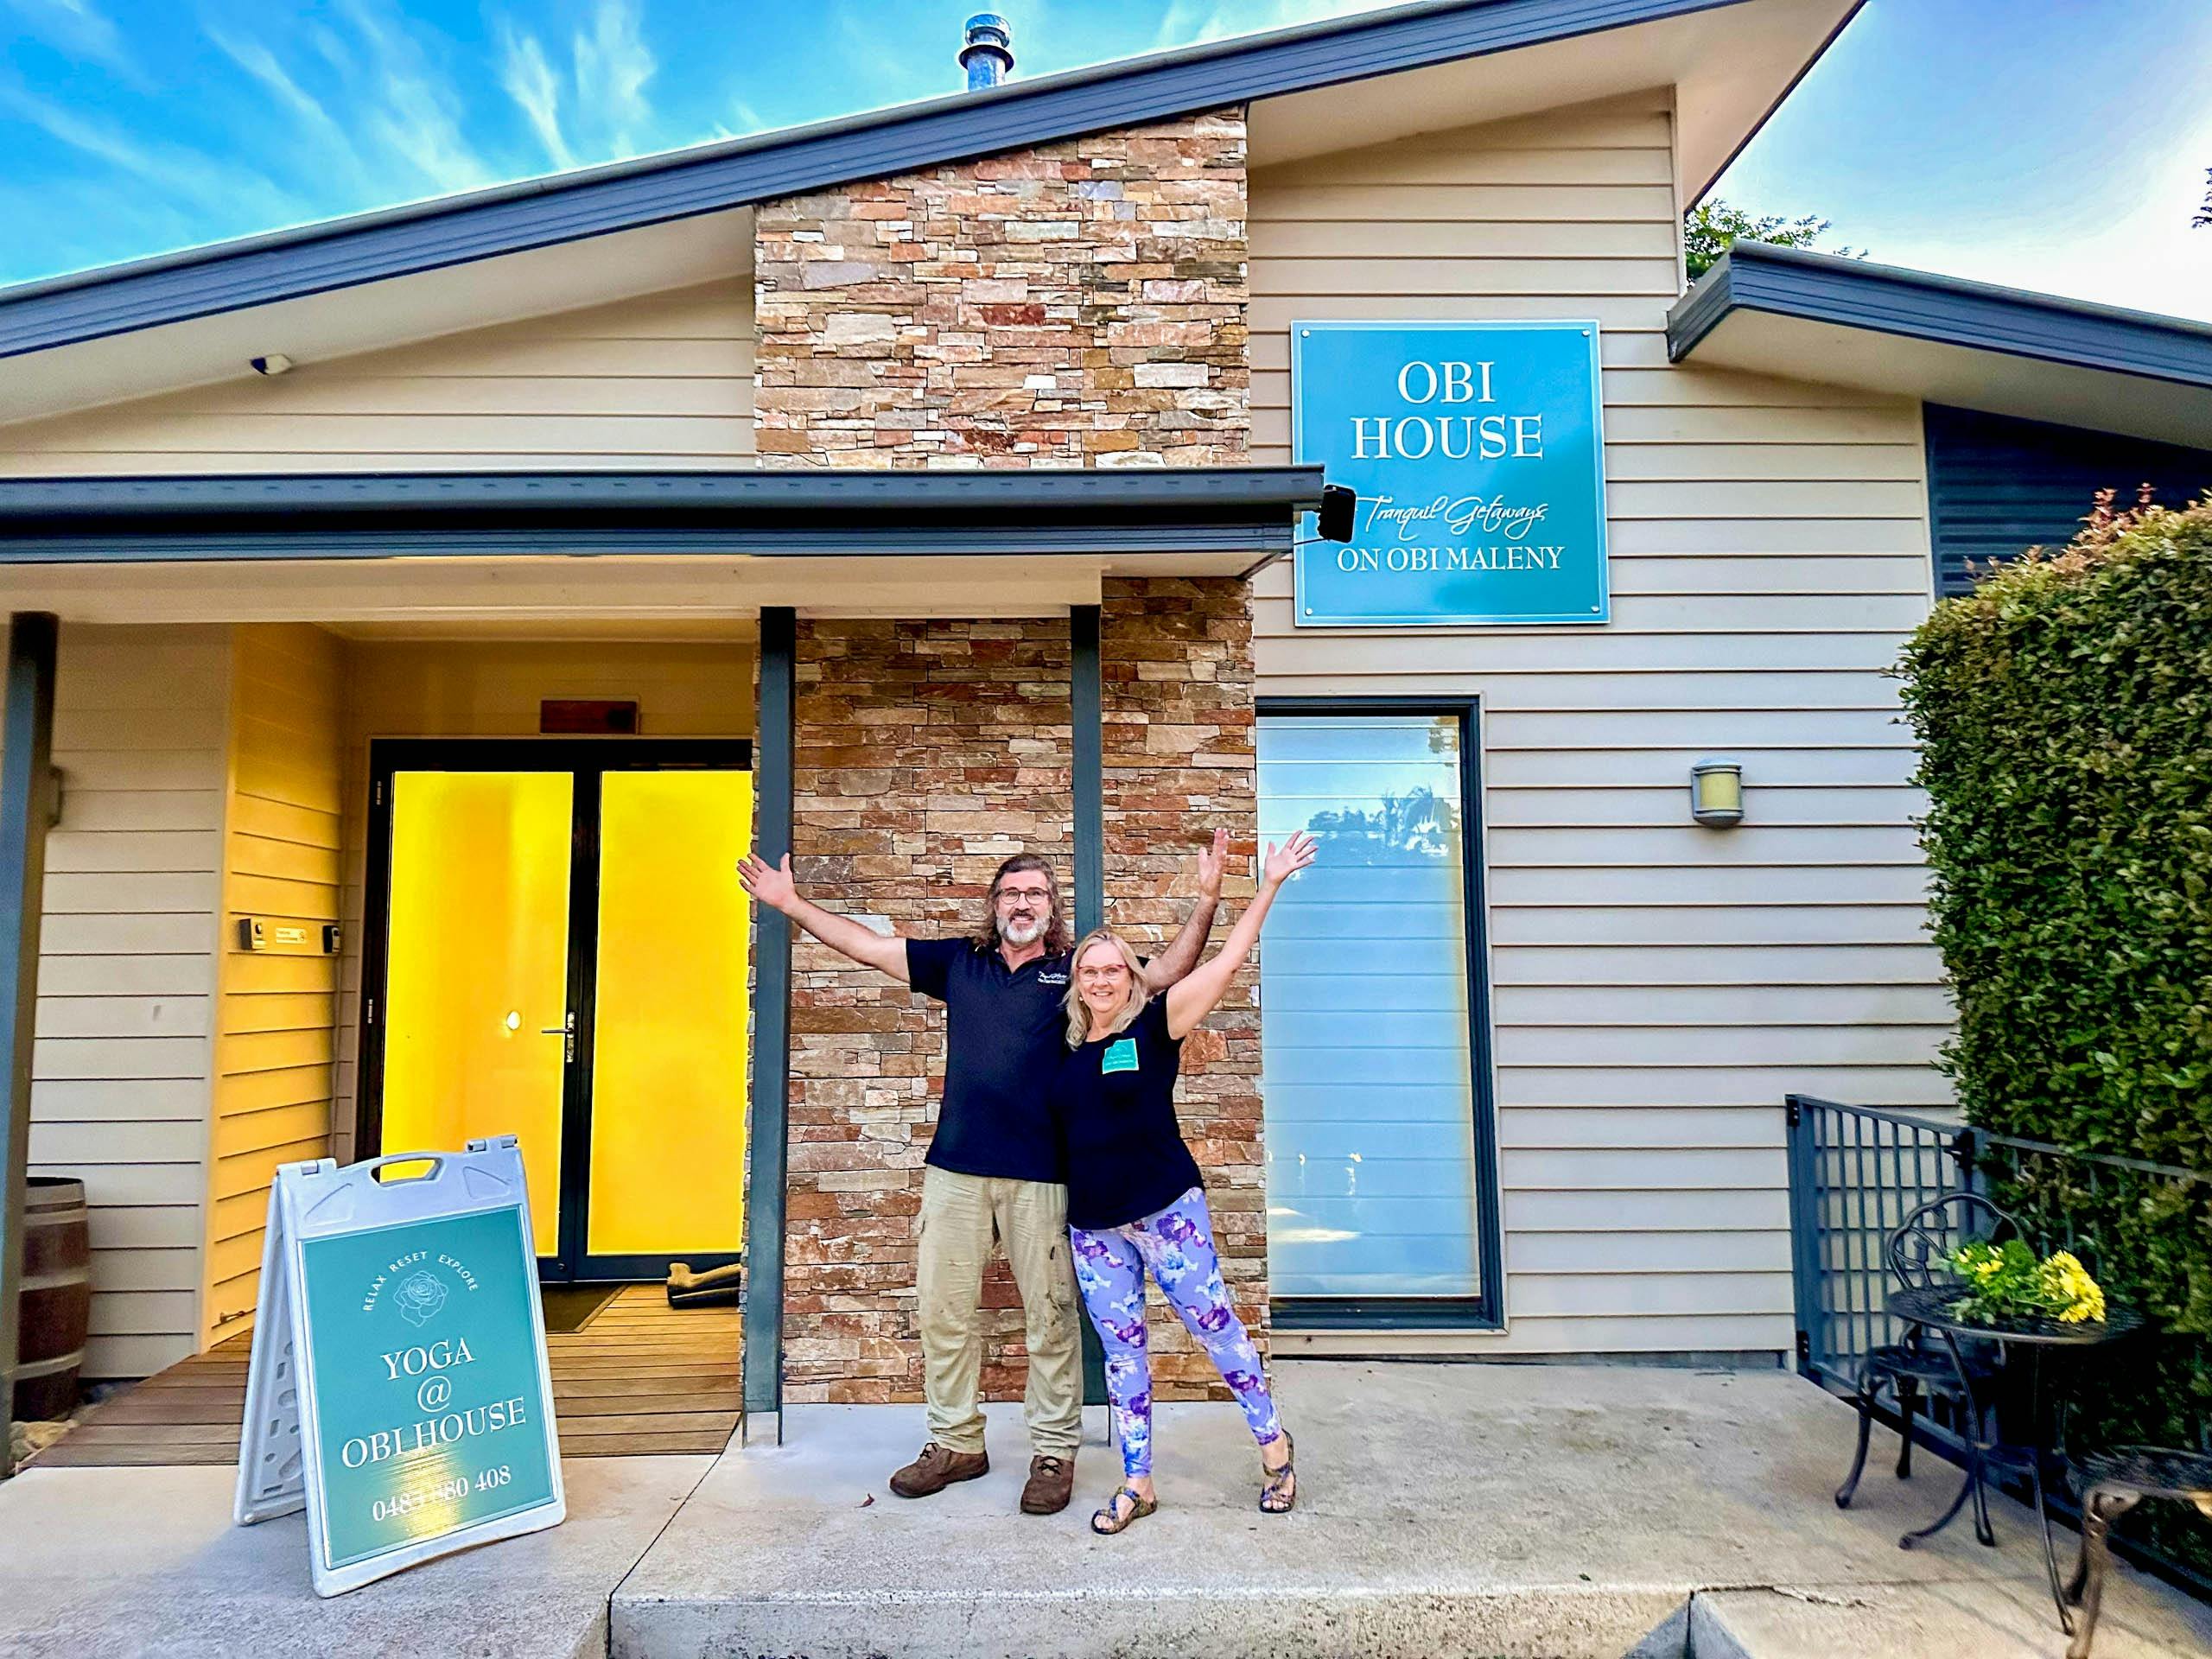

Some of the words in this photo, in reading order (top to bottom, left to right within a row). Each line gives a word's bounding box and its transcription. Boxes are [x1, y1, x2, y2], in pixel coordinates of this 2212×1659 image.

[1397, 361, 1497, 404] OBI
[1350, 414, 1544, 460] HOUSE
[1356, 495, 1449, 541] Tranquil
[1444, 494, 1549, 541] Getaways
[1337, 548, 1382, 572] ON
[1387, 547, 1440, 572] OBI
[1445, 545, 1566, 571] MALENY
[362, 1274, 387, 1312] RELAX
[389, 1250, 428, 1273] RESET
[438, 1254, 479, 1292] EXPLORE
[380, 1337, 477, 1382] YOGA
[416, 1375, 453, 1414] @
[341, 1427, 403, 1469] OBI
[412, 1396, 526, 1450] HOUSE
[431, 1477, 469, 1502] 80
[474, 1465, 512, 1492] 408
